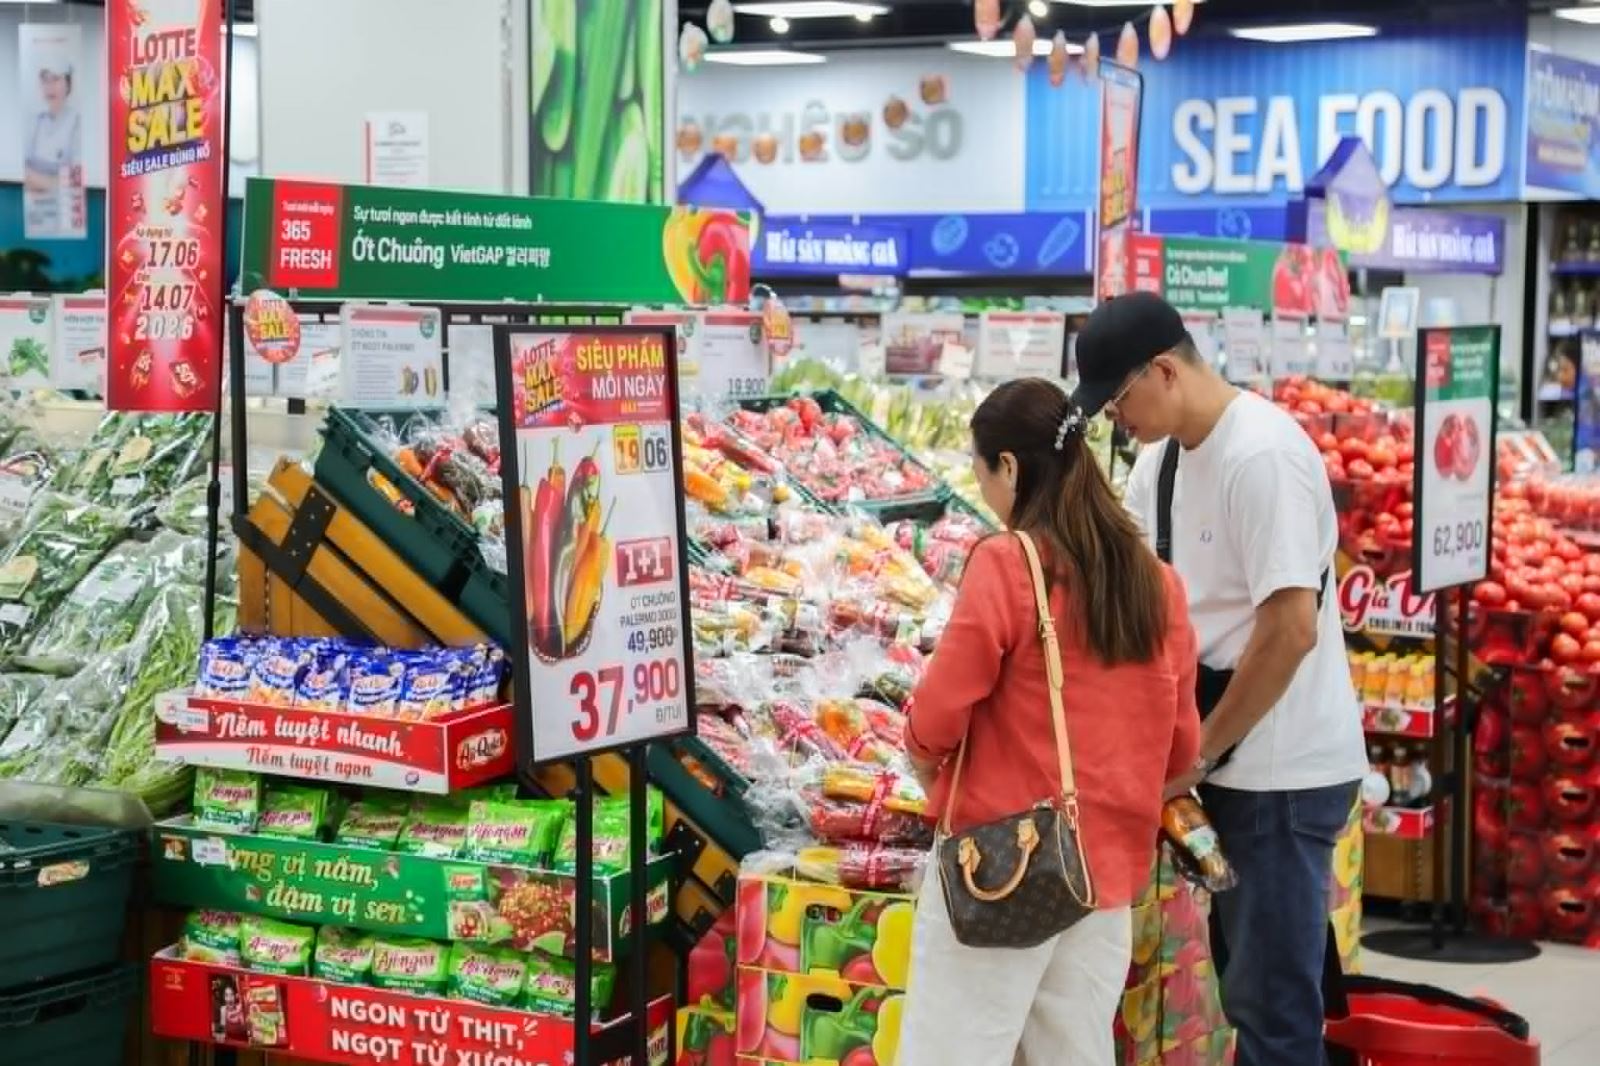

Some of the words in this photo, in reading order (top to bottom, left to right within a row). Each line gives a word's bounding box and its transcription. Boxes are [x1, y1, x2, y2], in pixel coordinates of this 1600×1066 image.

[132, 29, 196, 66] LOTTE
[131, 62, 198, 109] MAX
[127, 98, 203, 153] SALE
[1171, 94, 1305, 194] SEA
[1316, 87, 1507, 188] FOOD
[144, 153, 170, 171] SALE
[281, 219, 311, 241] 365
[393, 209, 418, 226] ngon
[148, 240, 198, 268] 17.06
[281, 247, 333, 270] FRESH
[352, 228, 376, 262] Ớt
[377, 235, 445, 269] Chuông
[451, 243, 505, 265] VietGAP
[142, 284, 194, 312] 14.07
[134, 314, 194, 341] 2026
[524, 337, 556, 365] LOTTE
[576, 338, 614, 371] SIÊU
[617, 336, 665, 369] PHẨM
[525, 378, 563, 413] SALE
[624, 372, 666, 398] NGÀY
[617, 438, 641, 471] 19
[644, 437, 668, 469] 06
[1433, 520, 1483, 558] 62,900
[625, 545, 664, 581] 1+1
[620, 612, 657, 628] PALERMO
[570, 657, 680, 742] 37,900
[274, 714, 331, 746] tuyệt
[336, 721, 404, 757] nhanh
[289, 752, 330, 776] tuyệt
[334, 760, 372, 779] ngon
[364, 900, 405, 923] sen
[331, 996, 406, 1028] NGON
[413, 1005, 450, 1034] TỪ
[457, 1015, 524, 1050] THỊT,
[332, 1029, 403, 1063] NGỌT
[411, 1039, 447, 1066] TỪ
